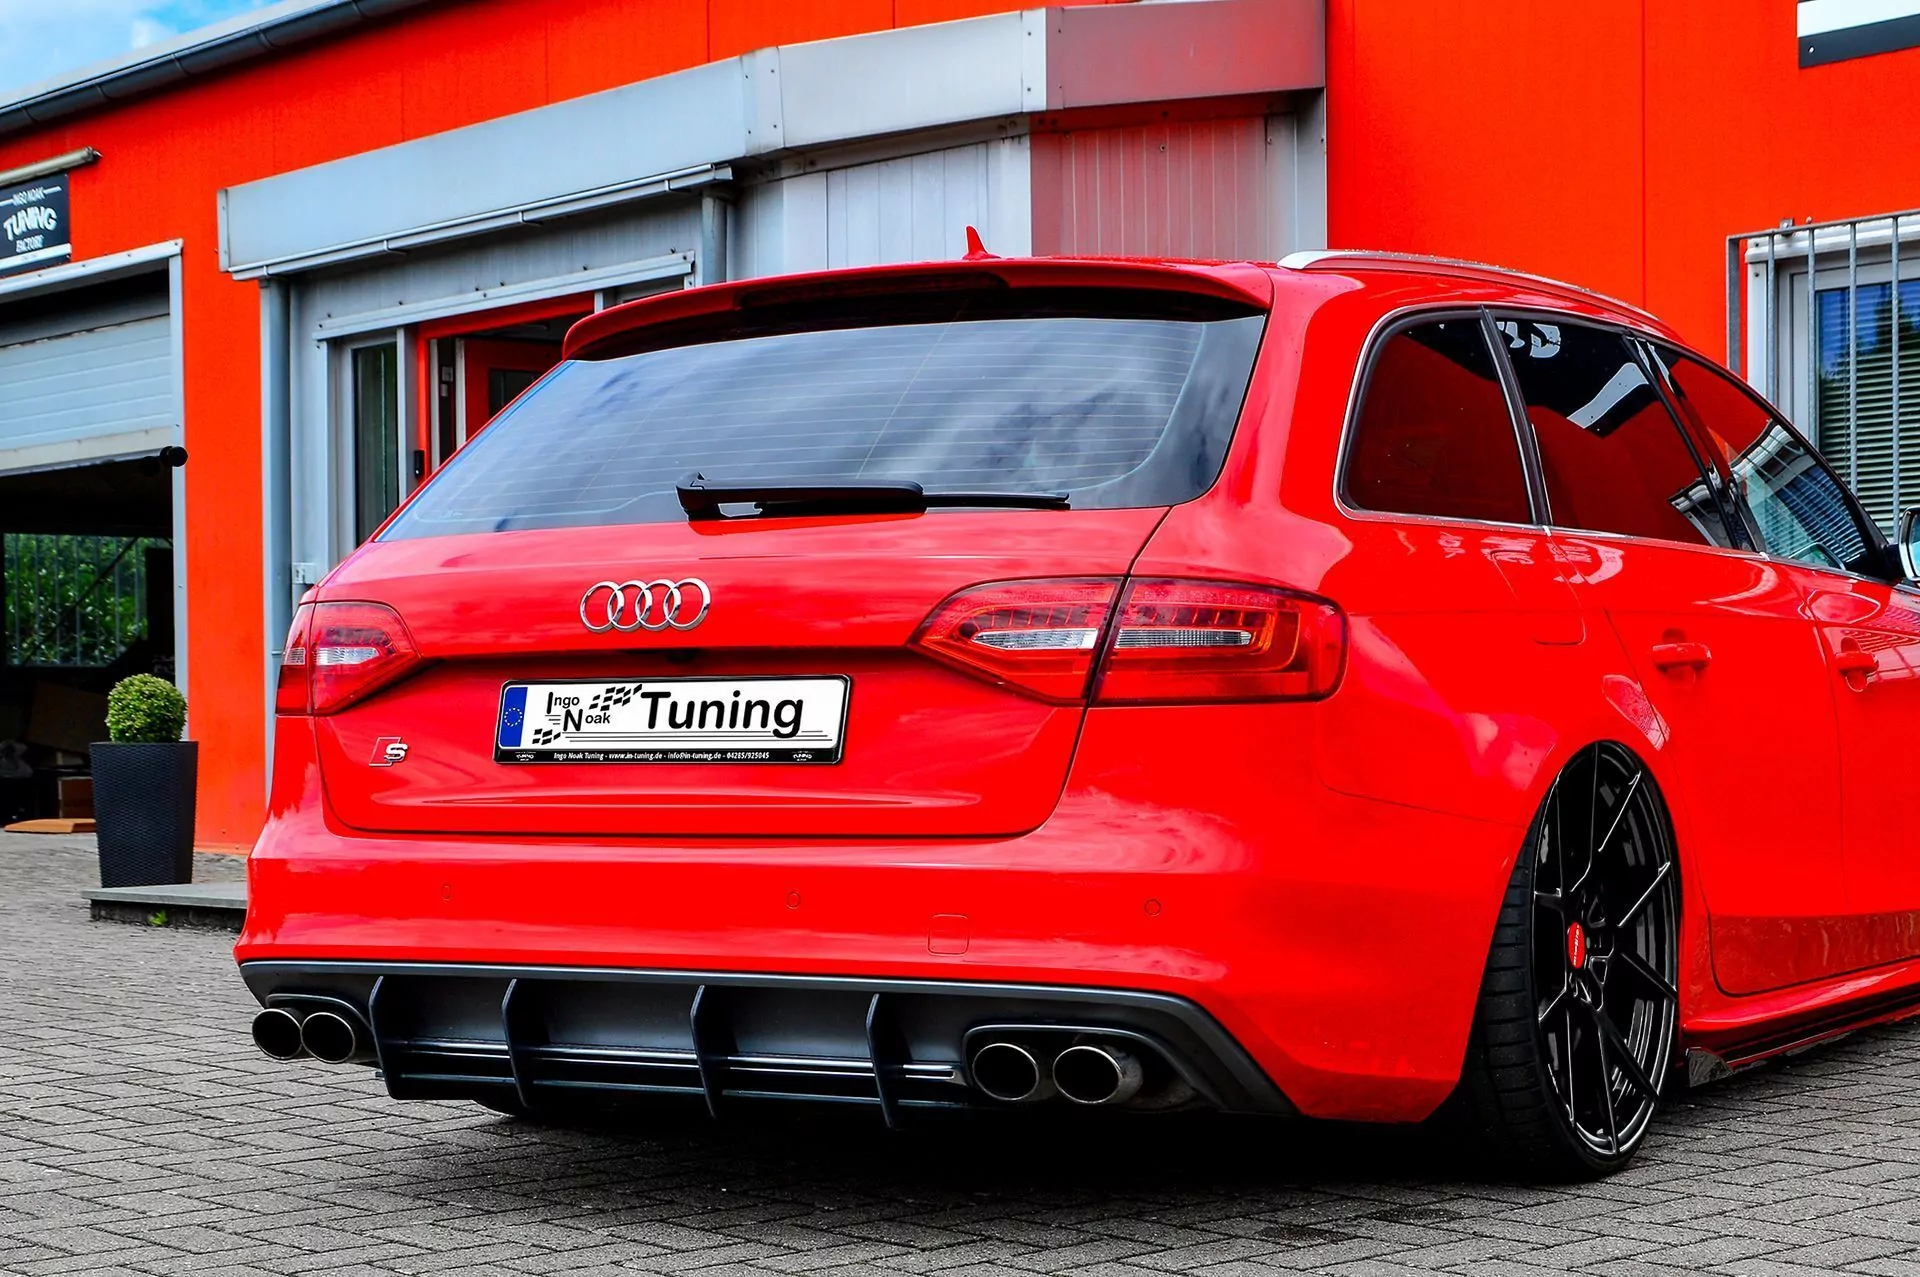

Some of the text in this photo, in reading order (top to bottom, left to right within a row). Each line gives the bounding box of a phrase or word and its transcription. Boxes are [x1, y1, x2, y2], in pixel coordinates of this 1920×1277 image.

[3, 206, 57, 241] TUNING
[546, 691, 580, 715] Ingo
[640, 690, 803, 739] Tuning
[563, 708, 611, 732] Noak
[383, 743, 409, 763] S
[553, 752, 567, 760] Ingo
[584, 752, 604, 760] Tuning
[609, 751, 662, 760] www.in-tuning.de
[667, 751, 721, 760] info@in-tuning.de
